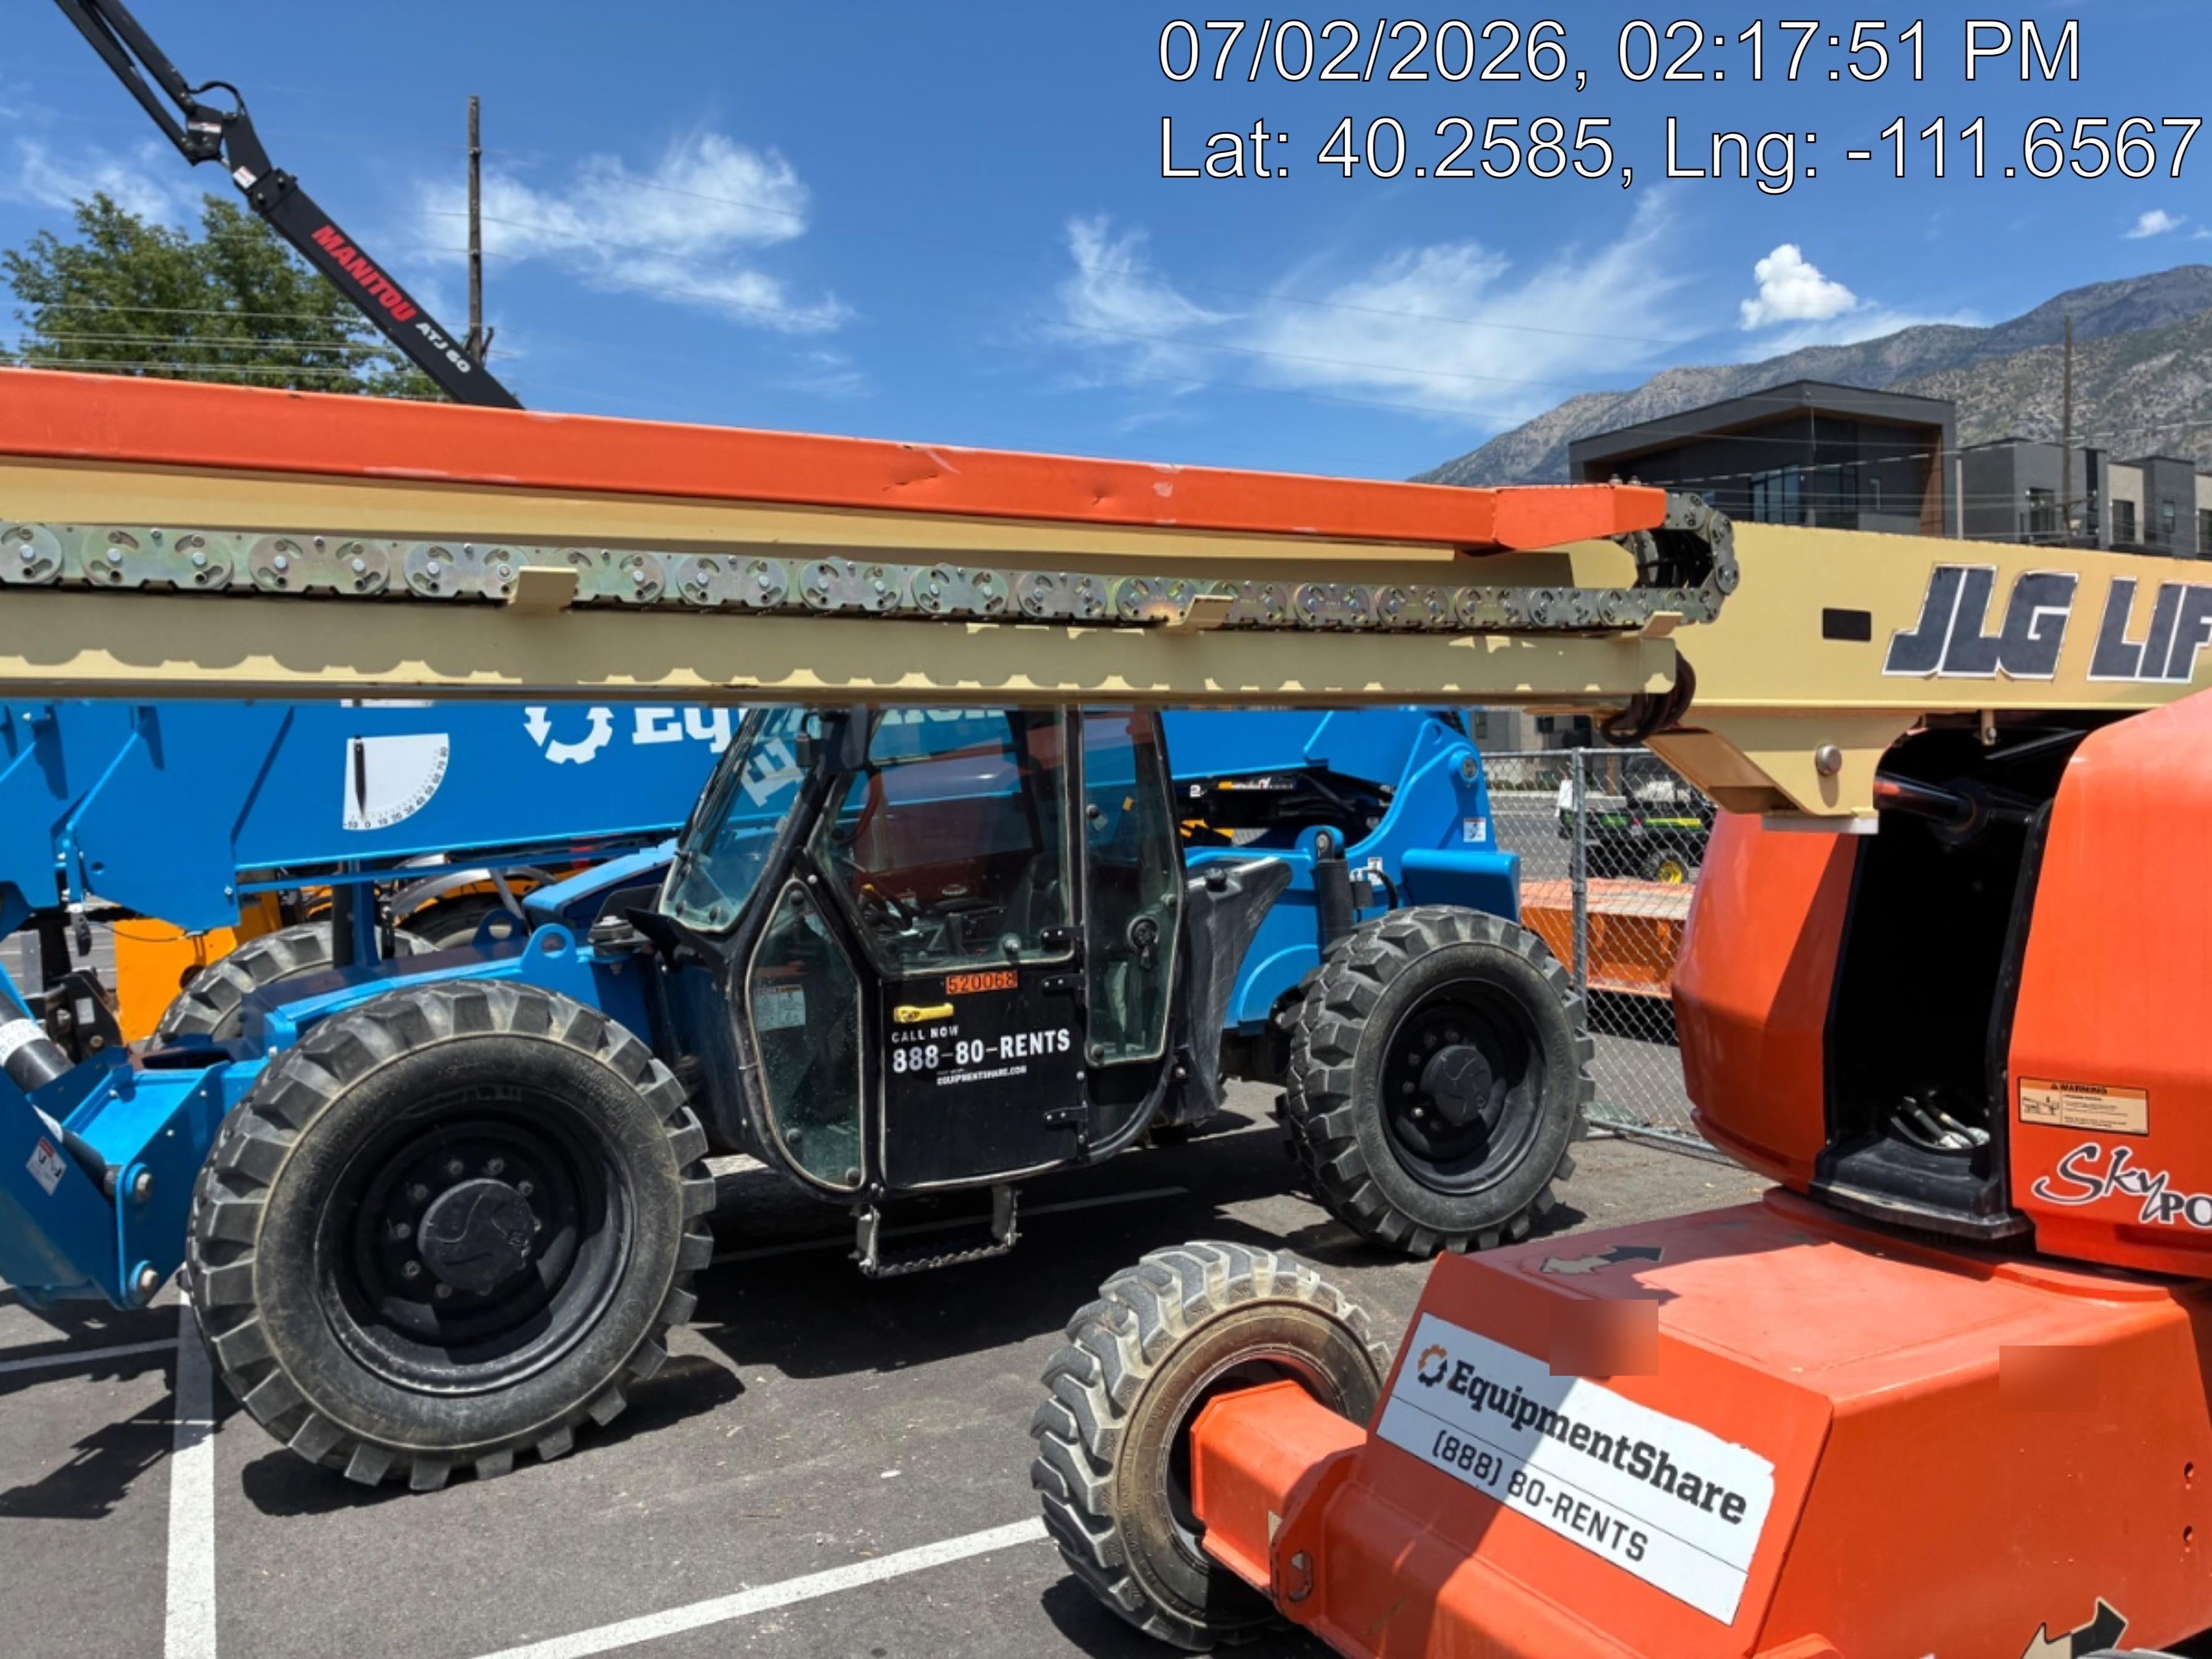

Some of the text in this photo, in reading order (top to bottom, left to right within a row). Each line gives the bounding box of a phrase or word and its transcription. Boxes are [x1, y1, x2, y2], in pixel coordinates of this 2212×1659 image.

[311, 225, 417, 322] MANITOU
[416, 323, 448, 349] ATJ
[1881, 563, 2079, 680] JLG
[892, 1025, 960, 1043] CALL NOW
[893, 1028, 1070, 1073] 888-80-RENTS
[1432, 1429, 1649, 1563] (888) 80-RENTS
[1447, 1359, 1747, 1524] EquipmentShare
